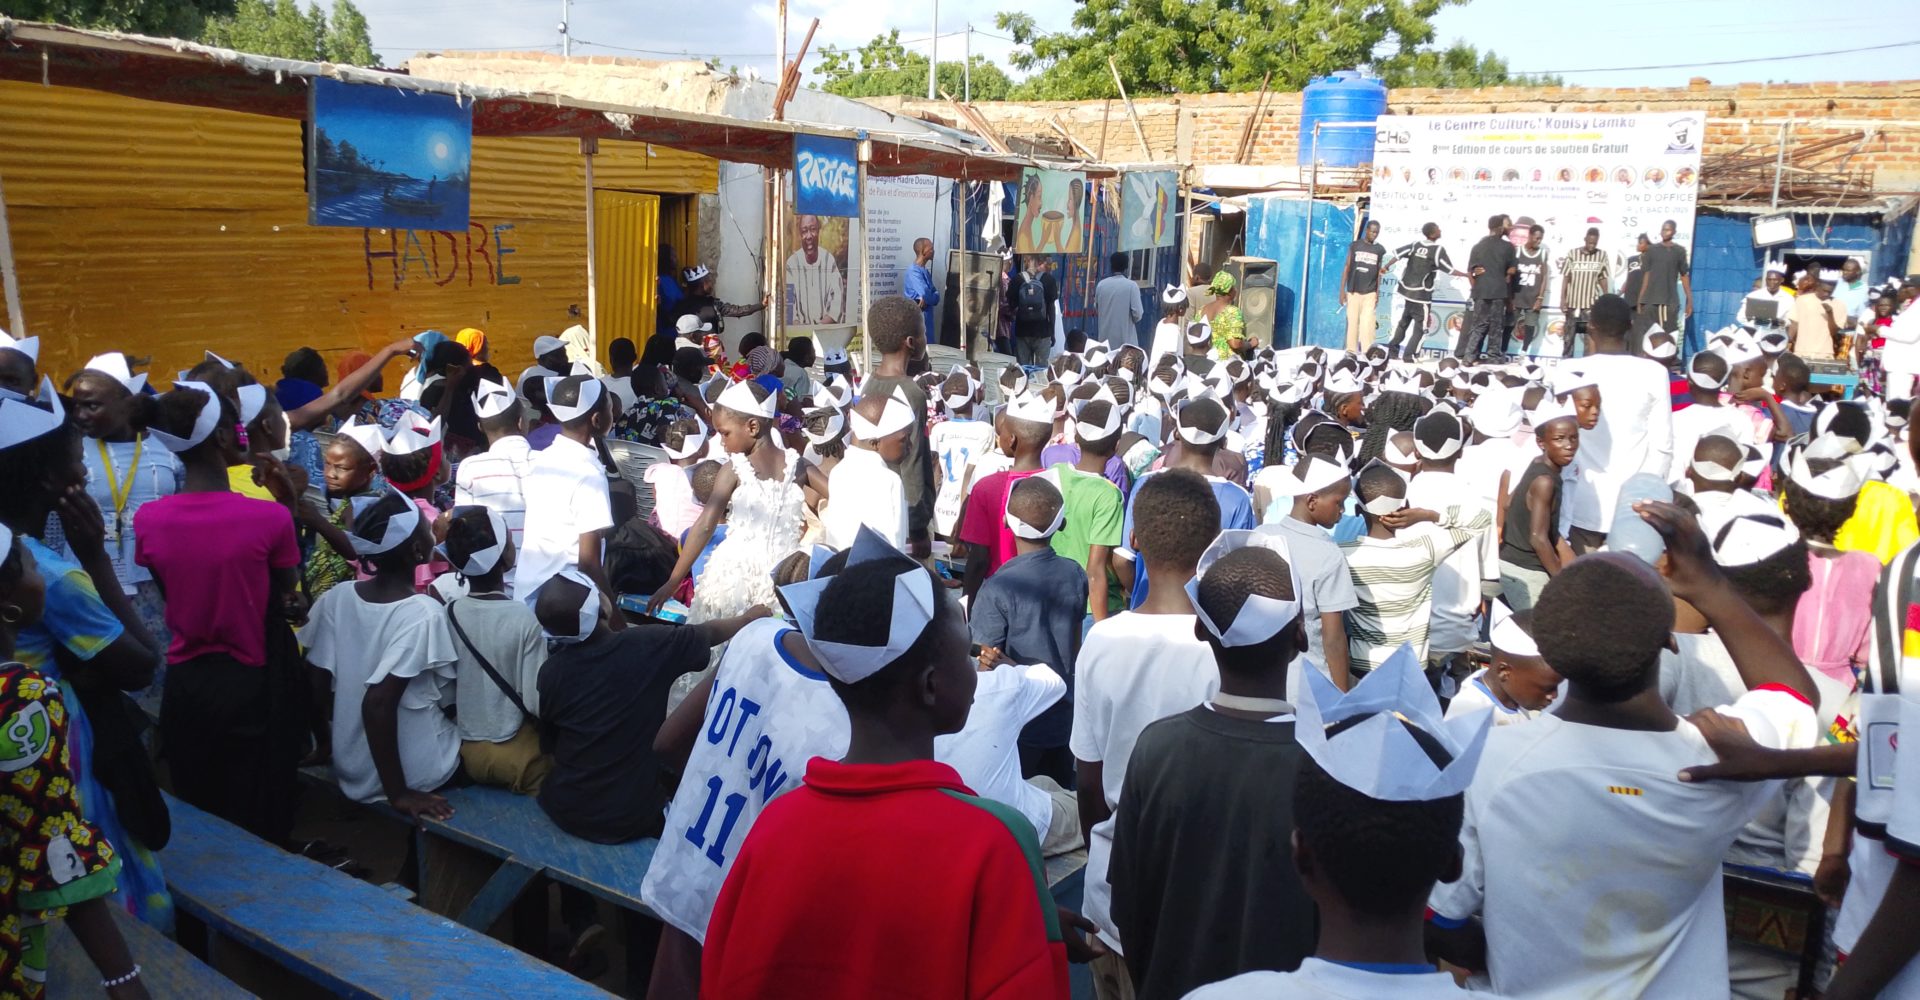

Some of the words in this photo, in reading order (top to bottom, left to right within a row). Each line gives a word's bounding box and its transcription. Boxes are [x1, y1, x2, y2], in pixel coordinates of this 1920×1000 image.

[1444, 119, 1486, 131] Centre
[1452, 144, 1486, 155] Edition
[1489, 144, 1501, 154] de
[1503, 146, 1533, 155] cours
[1592, 143, 1629, 154] Gratuit
[364, 221, 522, 291] HADRE
[684, 775, 748, 868] 11
